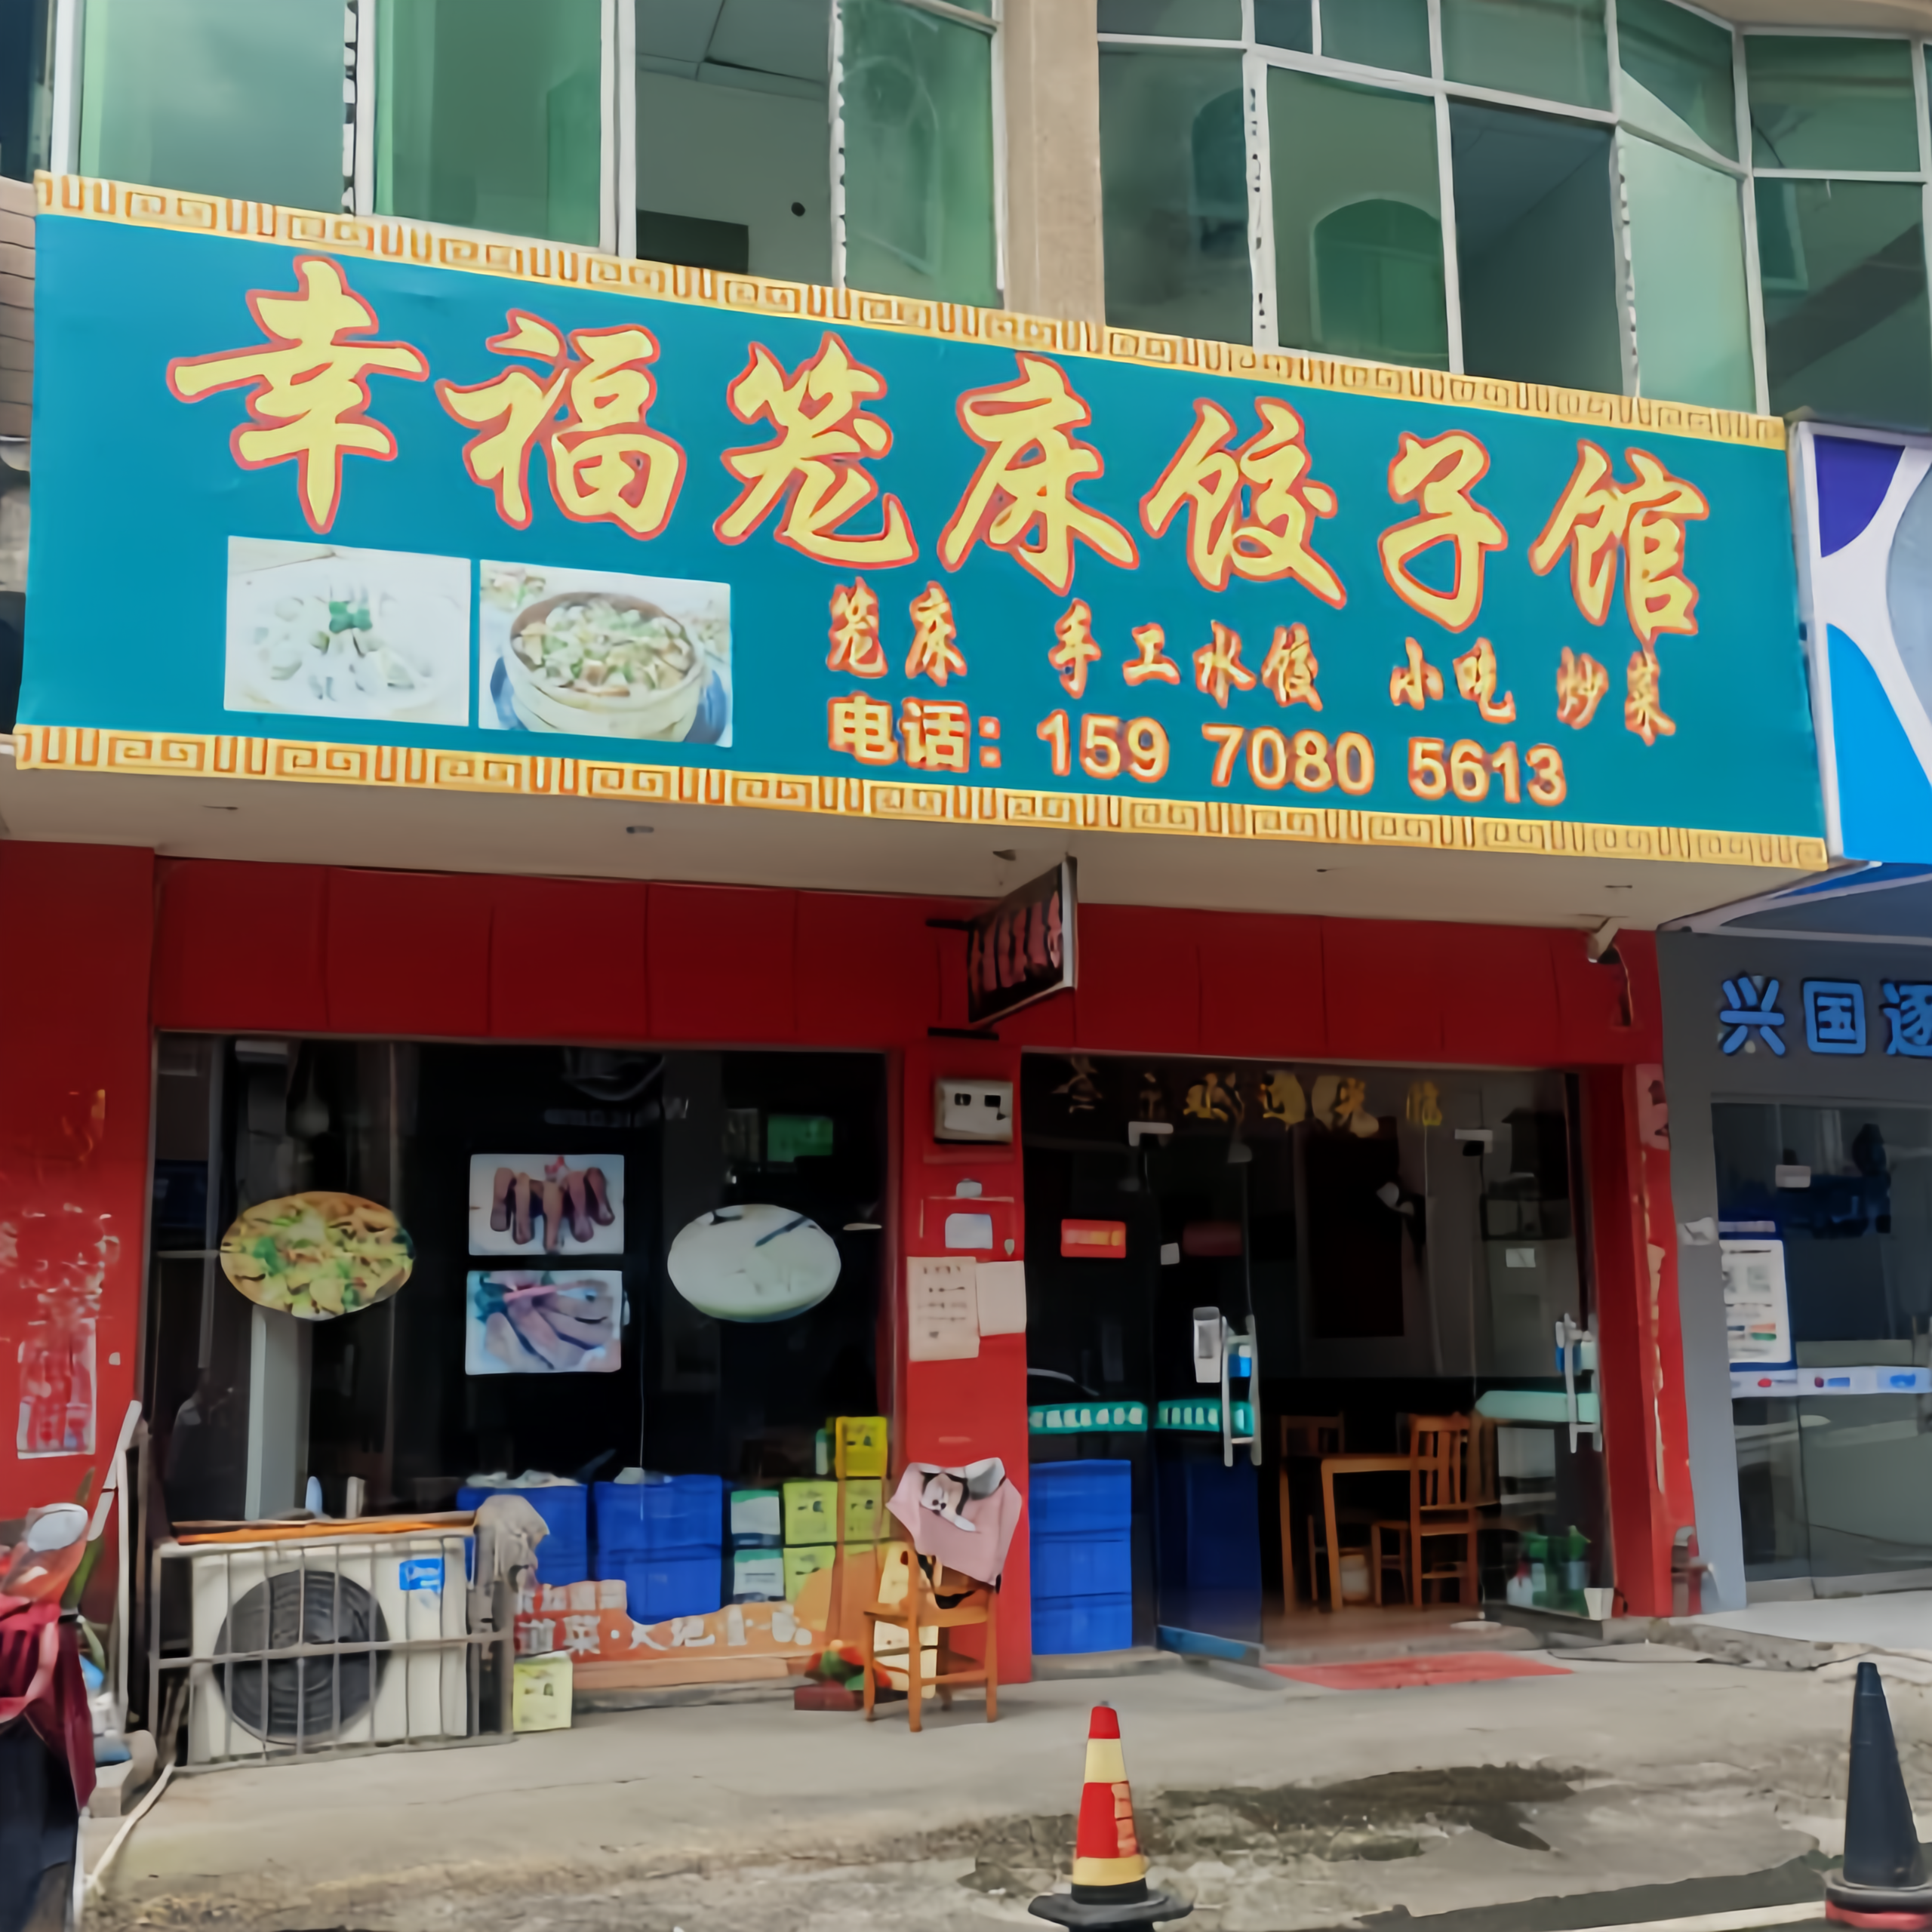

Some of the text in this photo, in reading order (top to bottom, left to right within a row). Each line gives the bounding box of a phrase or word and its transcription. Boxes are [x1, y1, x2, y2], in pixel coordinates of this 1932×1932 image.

[166, 255, 1710, 638] 幸福笼床饺子馆
[826, 576, 967, 687] 笼床
[1048, 597, 1322, 712] 手工水饺
[1036, 708, 1169, 783] 159
[1201, 722, 1374, 795] 7080
[1408, 737, 1567, 807] 5613
